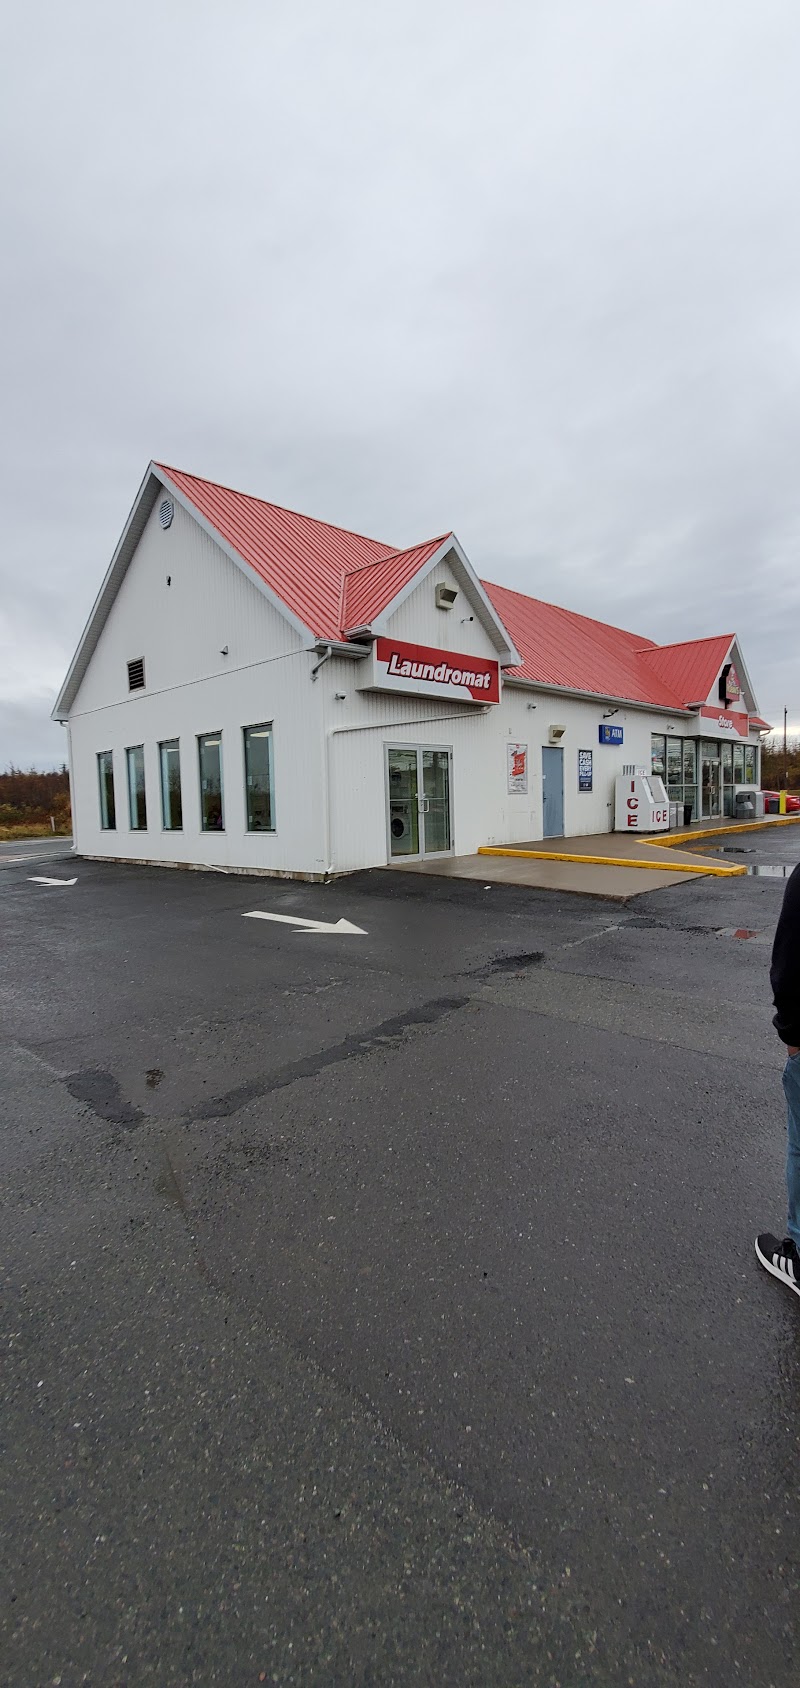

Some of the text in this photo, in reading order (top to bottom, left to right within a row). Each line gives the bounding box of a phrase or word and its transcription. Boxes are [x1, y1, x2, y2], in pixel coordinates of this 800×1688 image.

[388, 653, 490, 689] Laundromat
[718, 715, 733, 728] Store
[611, 729, 622, 739] ATM
[579, 751, 592, 759] SAVE
[627, 780, 639, 827] ICE
[652, 810, 667, 823] ICE
